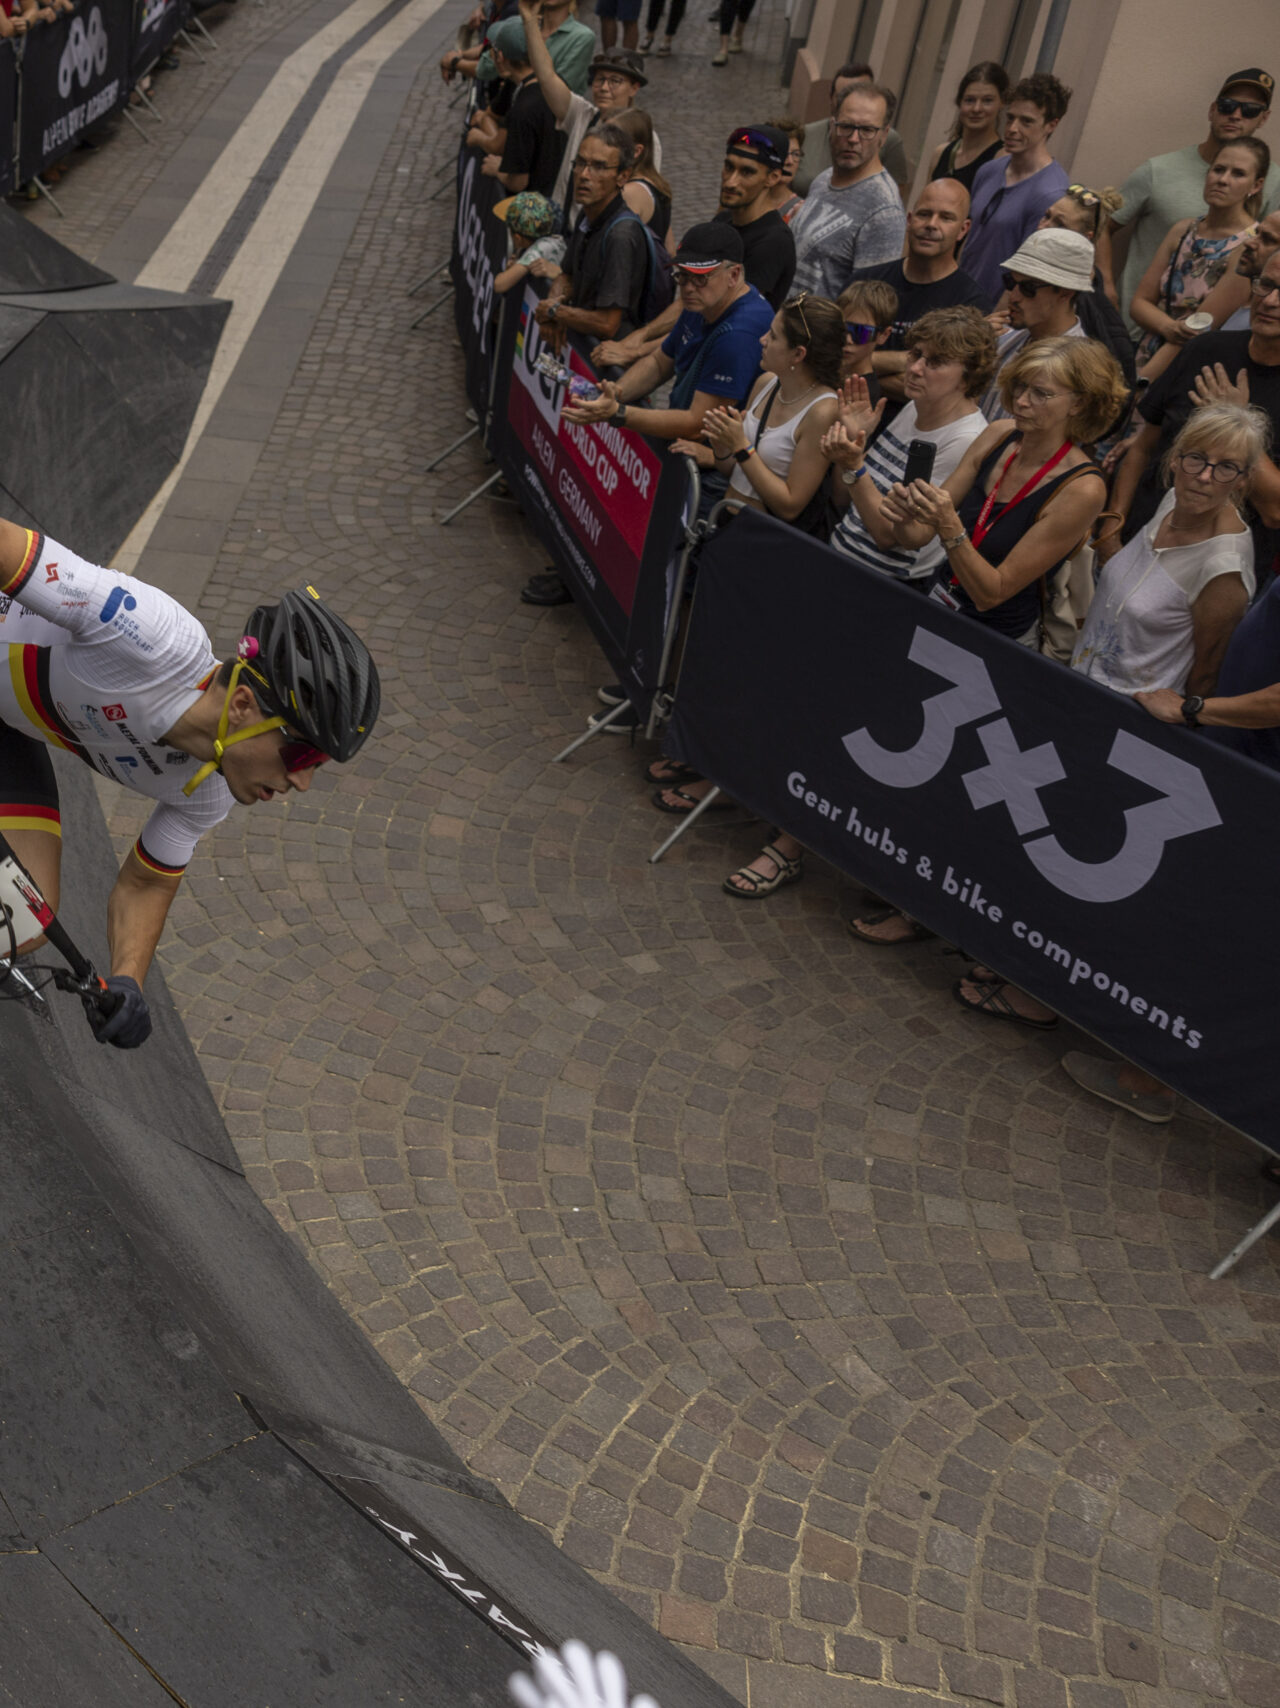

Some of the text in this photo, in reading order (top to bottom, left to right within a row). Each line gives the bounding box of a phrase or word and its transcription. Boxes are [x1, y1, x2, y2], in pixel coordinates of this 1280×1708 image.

[532, 423, 556, 476] AALEN
[559, 468, 603, 546] GERMANY
[596, 454, 618, 496] CUP
[786, 771, 1205, 1050] Gear hubs & bike components
[378, 1517, 563, 1667] RATKY
